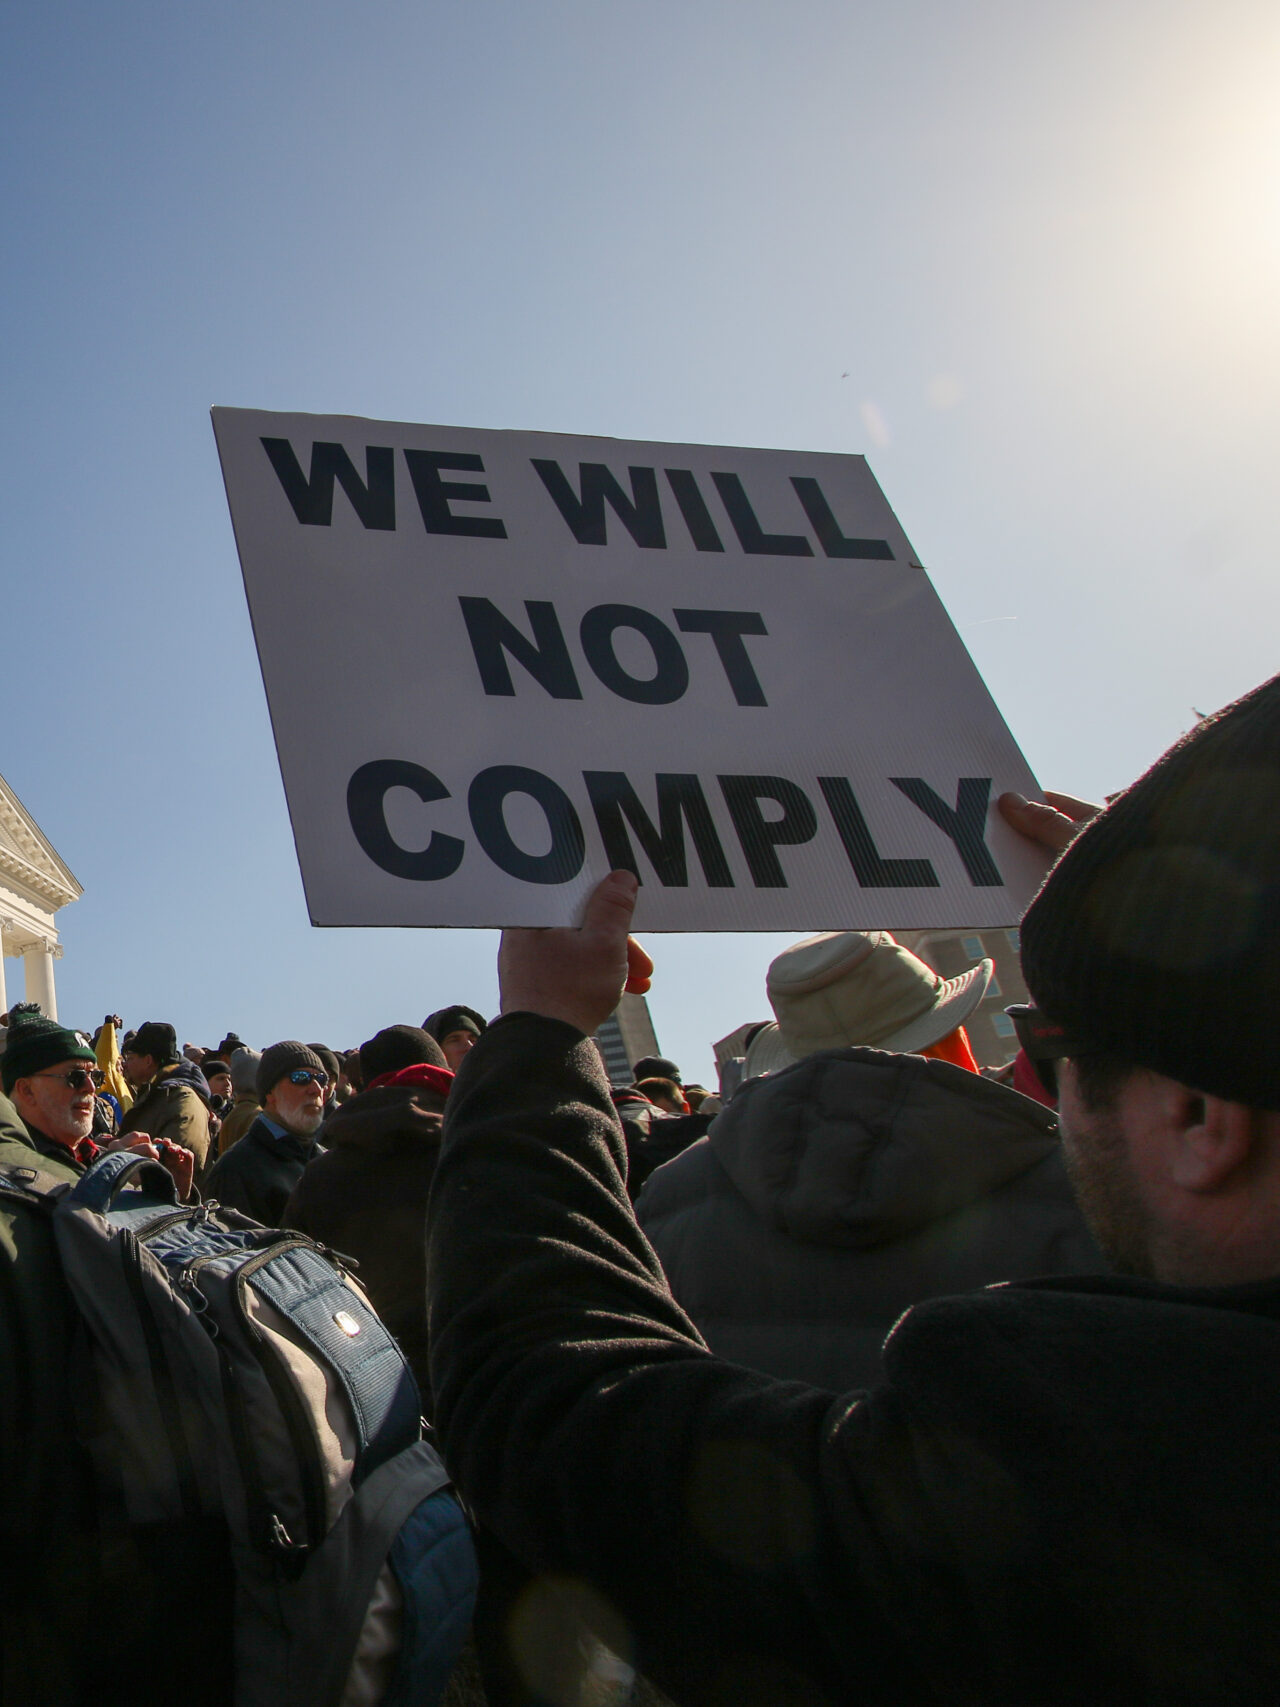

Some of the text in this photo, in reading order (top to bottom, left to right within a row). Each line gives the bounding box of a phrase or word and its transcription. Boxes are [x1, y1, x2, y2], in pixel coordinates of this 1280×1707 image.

[260, 436, 896, 562] WE WILL
[457, 595, 769, 708] NOT
[345, 758, 1006, 889] COMPLY
